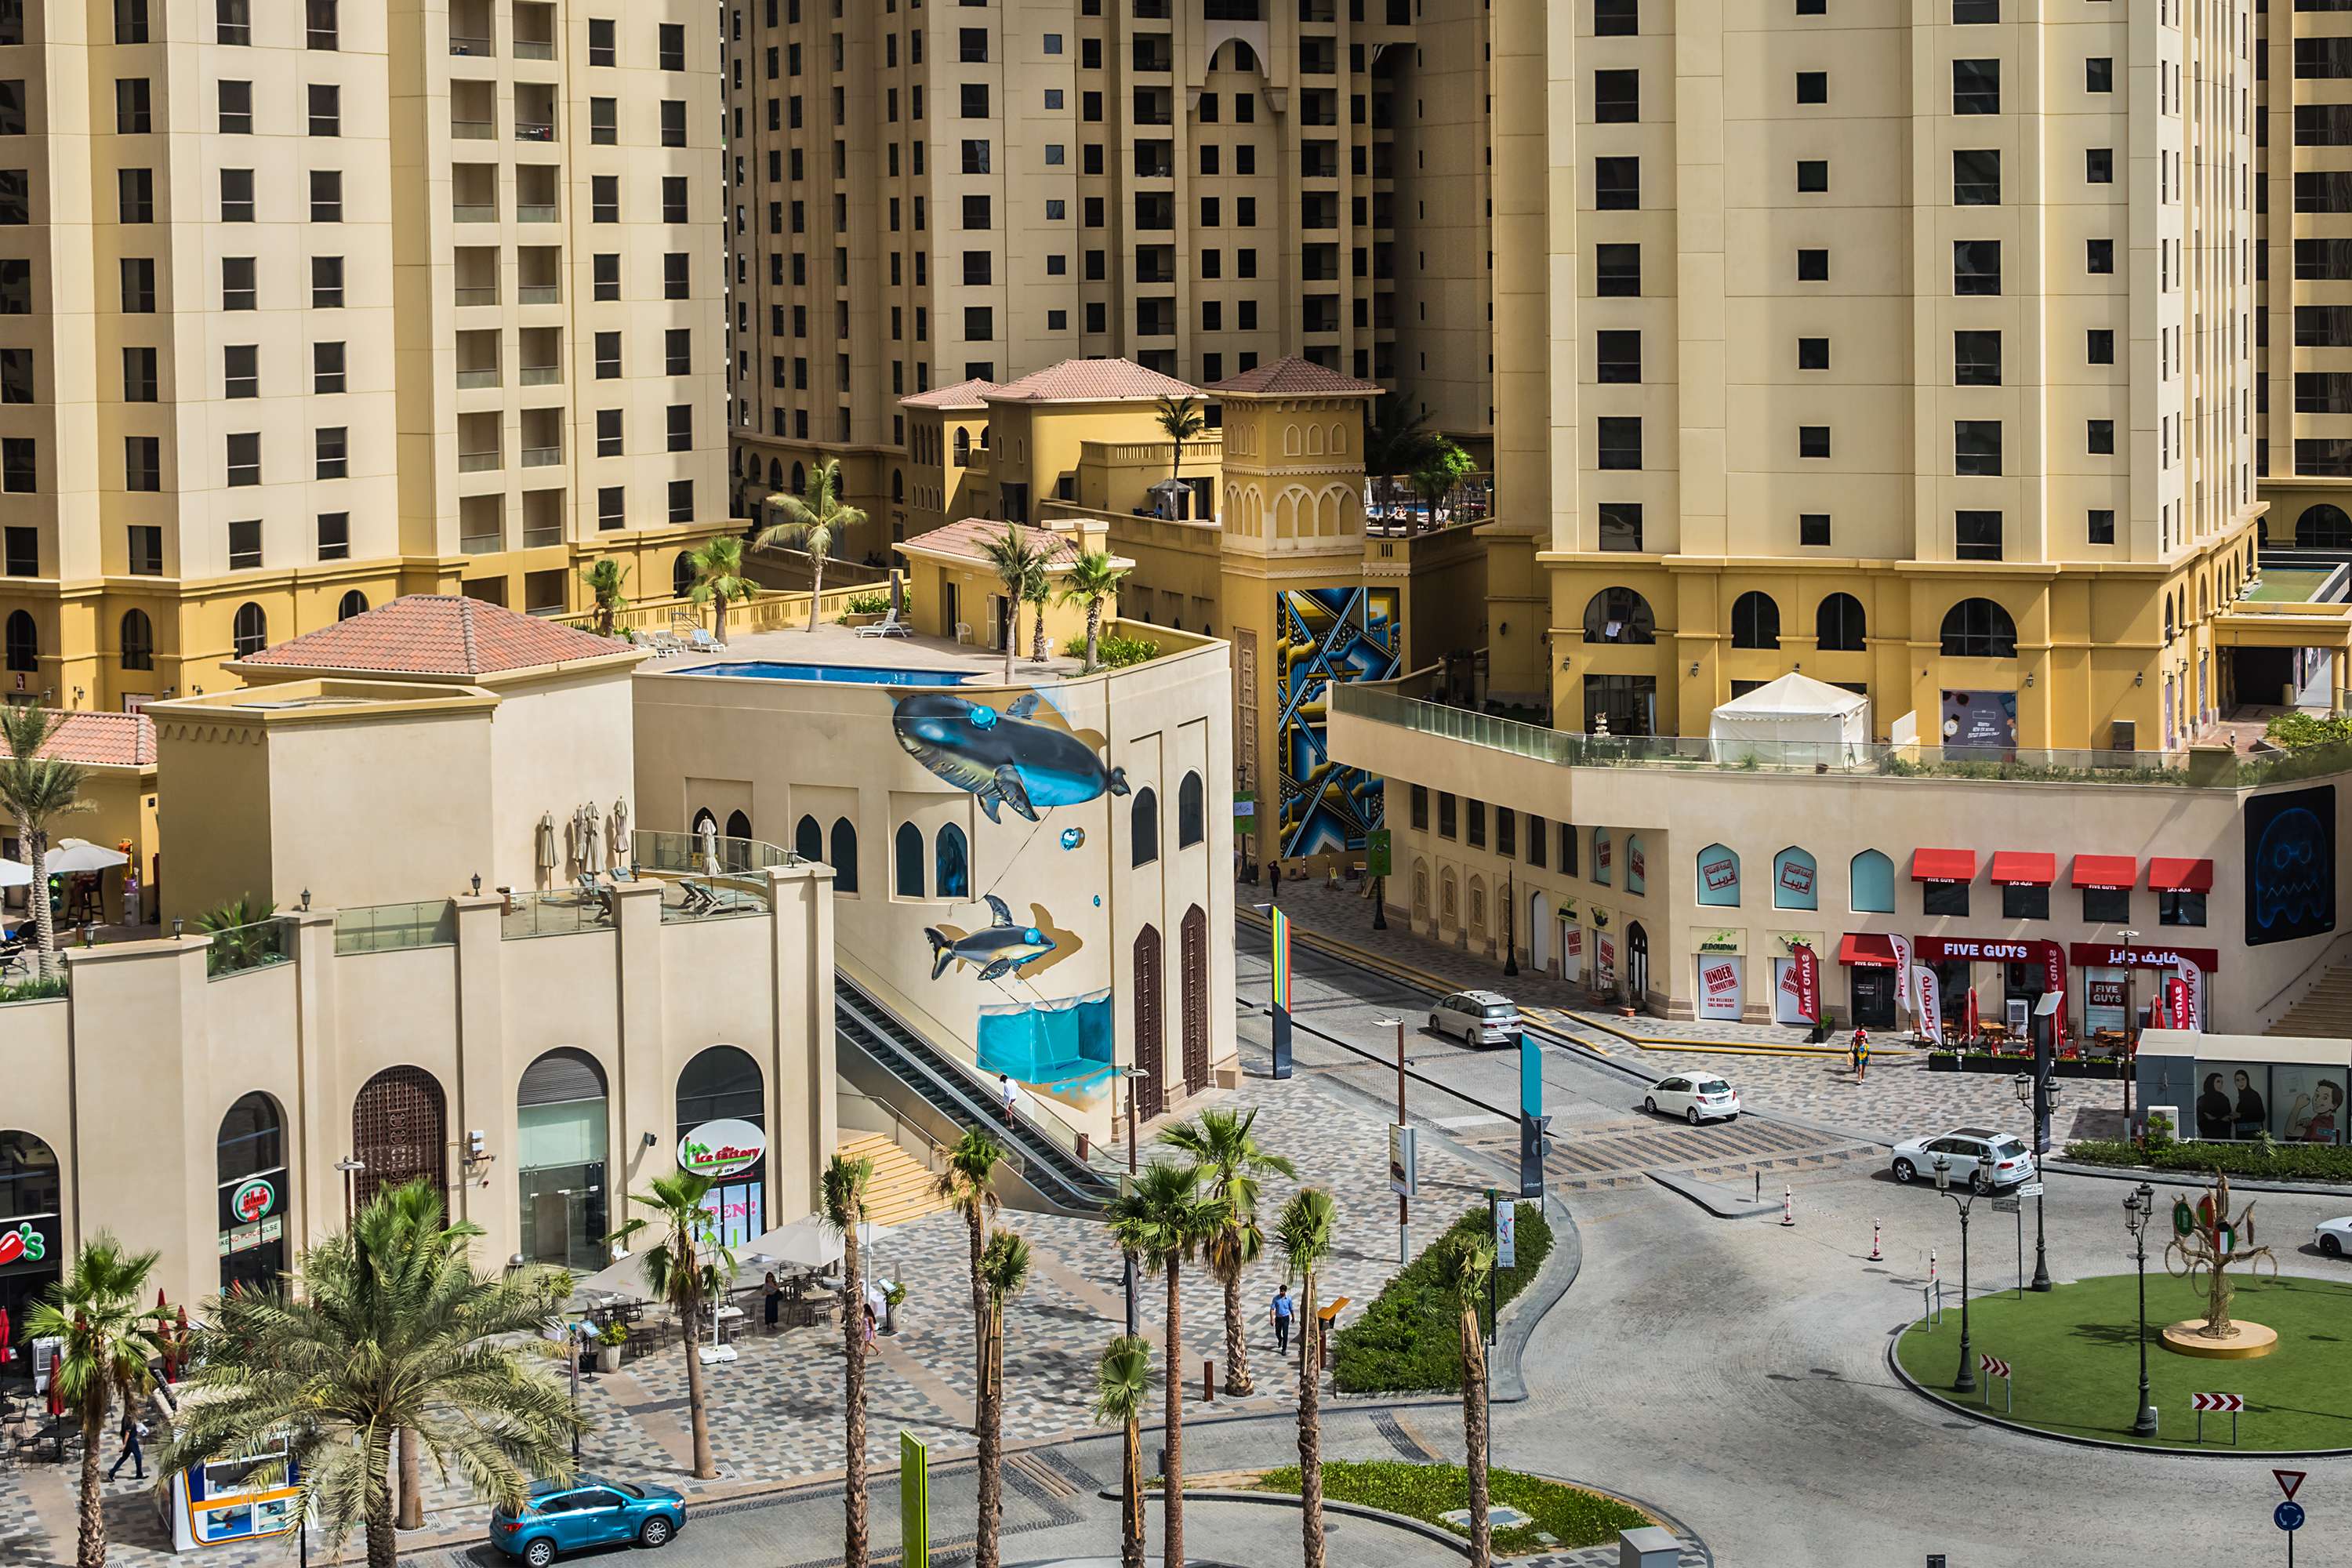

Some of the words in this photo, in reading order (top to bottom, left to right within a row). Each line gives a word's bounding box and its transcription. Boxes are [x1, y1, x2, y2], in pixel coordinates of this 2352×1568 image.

[1944, 943, 1979, 956] FIVE
[1984, 945, 2027, 958] GUYS
[2141, 951, 2180, 965] فايف
[1705, 966, 1733, 984] UNDER
[1709, 978, 1737, 993] RENOVATION
[2093, 994, 2122, 1003] GUYS
[262, 1223, 278, 1233] ELSE
